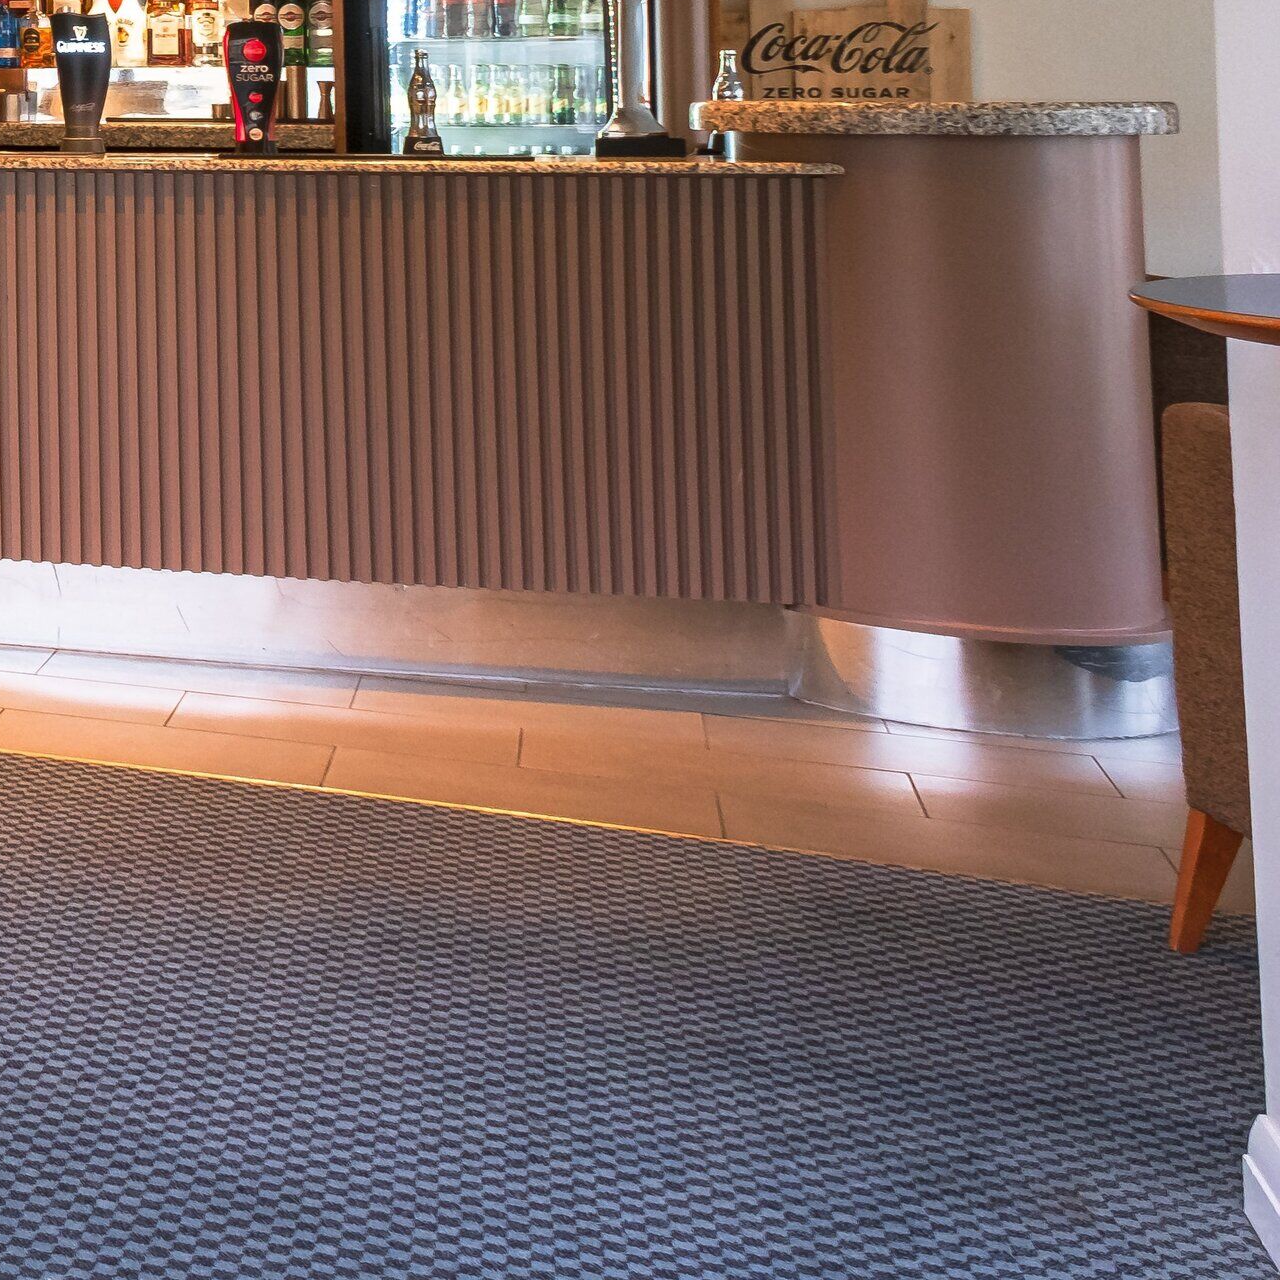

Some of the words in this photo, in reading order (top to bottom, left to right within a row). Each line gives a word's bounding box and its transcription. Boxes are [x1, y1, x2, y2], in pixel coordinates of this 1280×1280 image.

[741, 21, 939, 74] Coca-Cola
[240, 64, 269, 73] zero
[235, 73, 275, 82] SUGAR
[762, 87, 822, 99] ZERO
[830, 87, 911, 99] SUGAR
